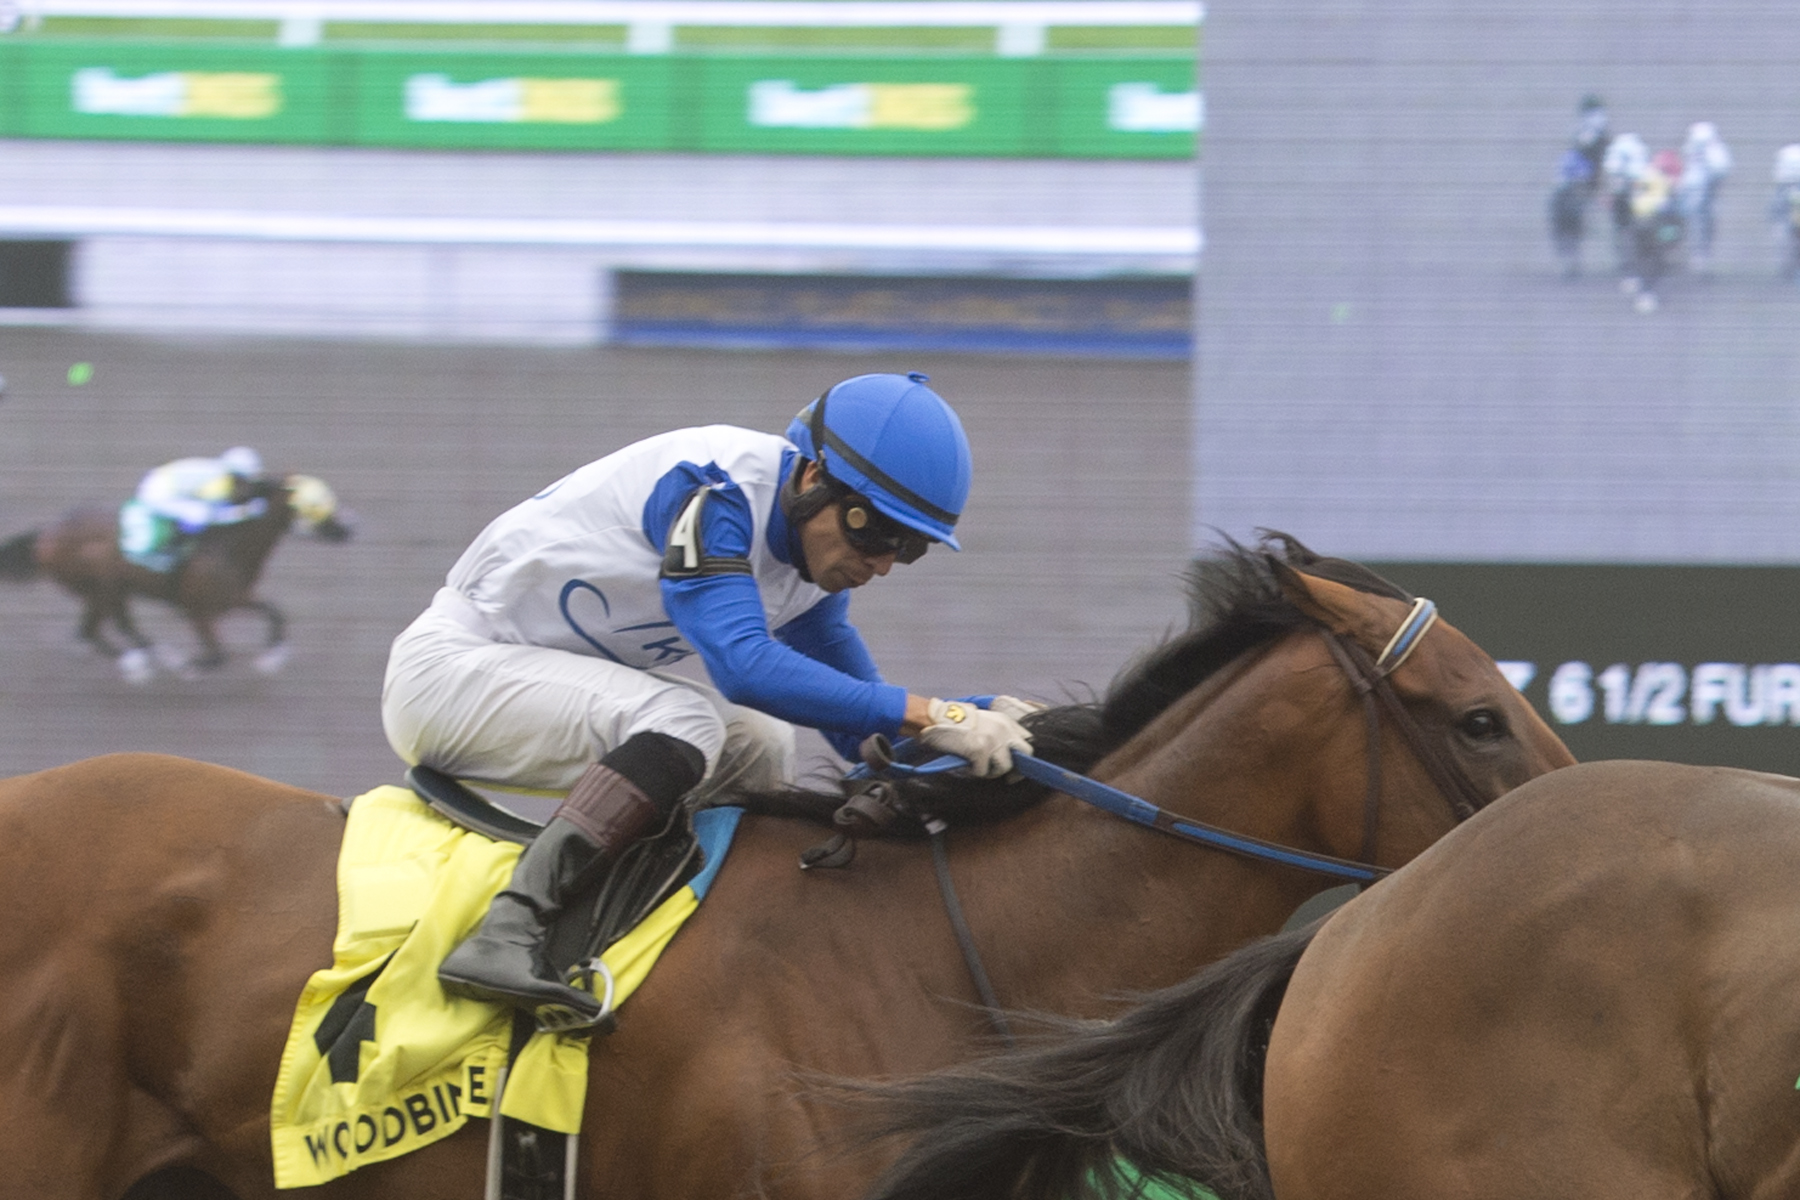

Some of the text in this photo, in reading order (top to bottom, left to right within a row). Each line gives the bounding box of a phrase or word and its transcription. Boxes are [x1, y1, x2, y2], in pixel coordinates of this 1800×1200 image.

[670, 494, 700, 569] 4
[1549, 660, 1595, 725] 6
[1597, 661, 1688, 726] 1/2
[304, 1066, 489, 1168] WOODBINE
